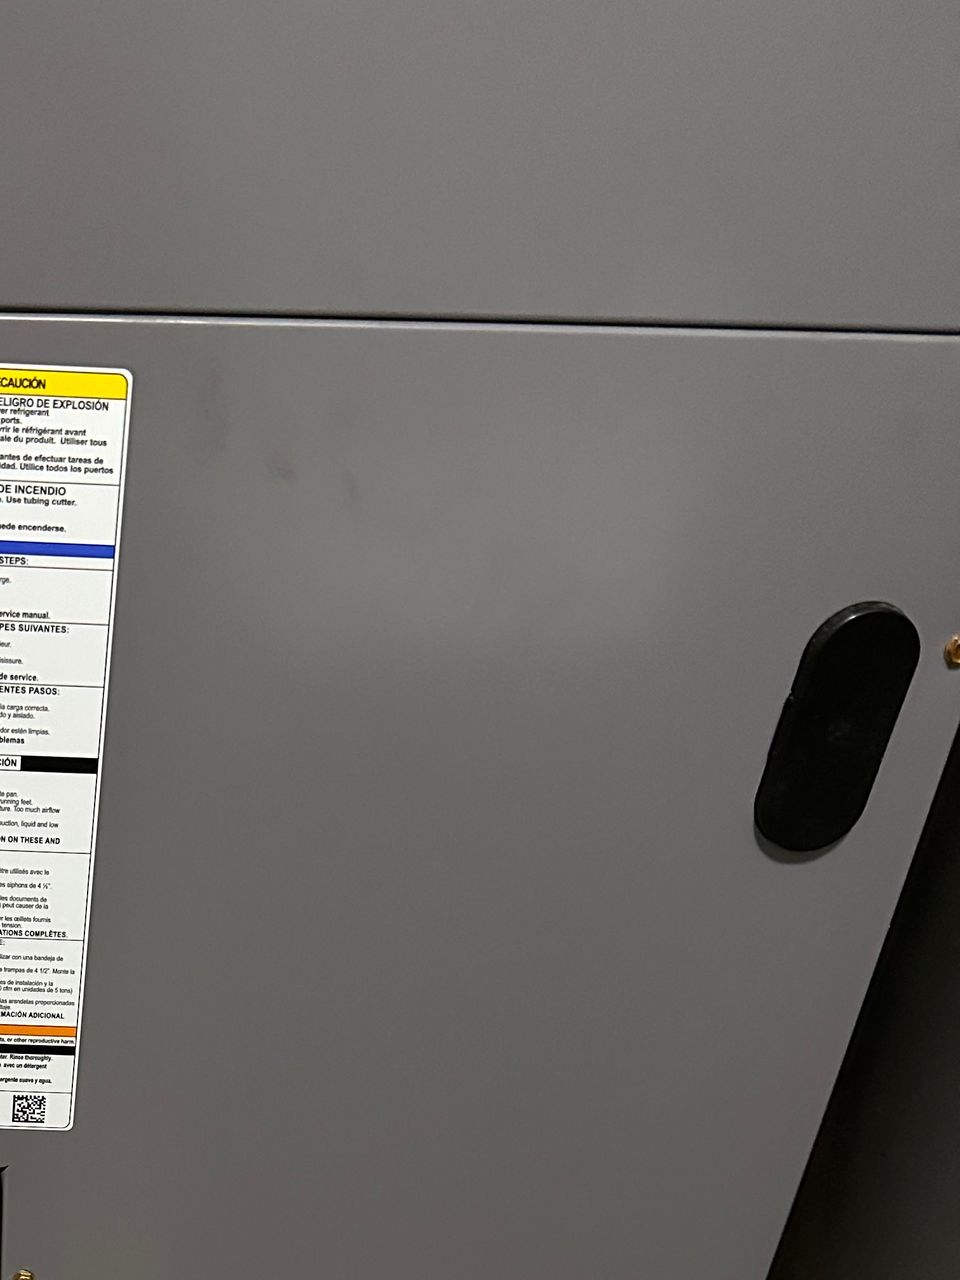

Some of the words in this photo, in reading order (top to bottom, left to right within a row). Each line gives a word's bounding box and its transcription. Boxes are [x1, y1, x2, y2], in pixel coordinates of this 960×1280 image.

[36, 399, 50, 408] DE
[52, 398, 109, 410] EXPLOSIÓN
[9, 408, 49, 417] refrigerant
[14, 484, 66, 495] INCENDIO
[5, 495, 21, 503] Use
[23, 496, 49, 506] tubing
[51, 497, 77, 505] cutter.
[21, 610, 51, 618] manual.
